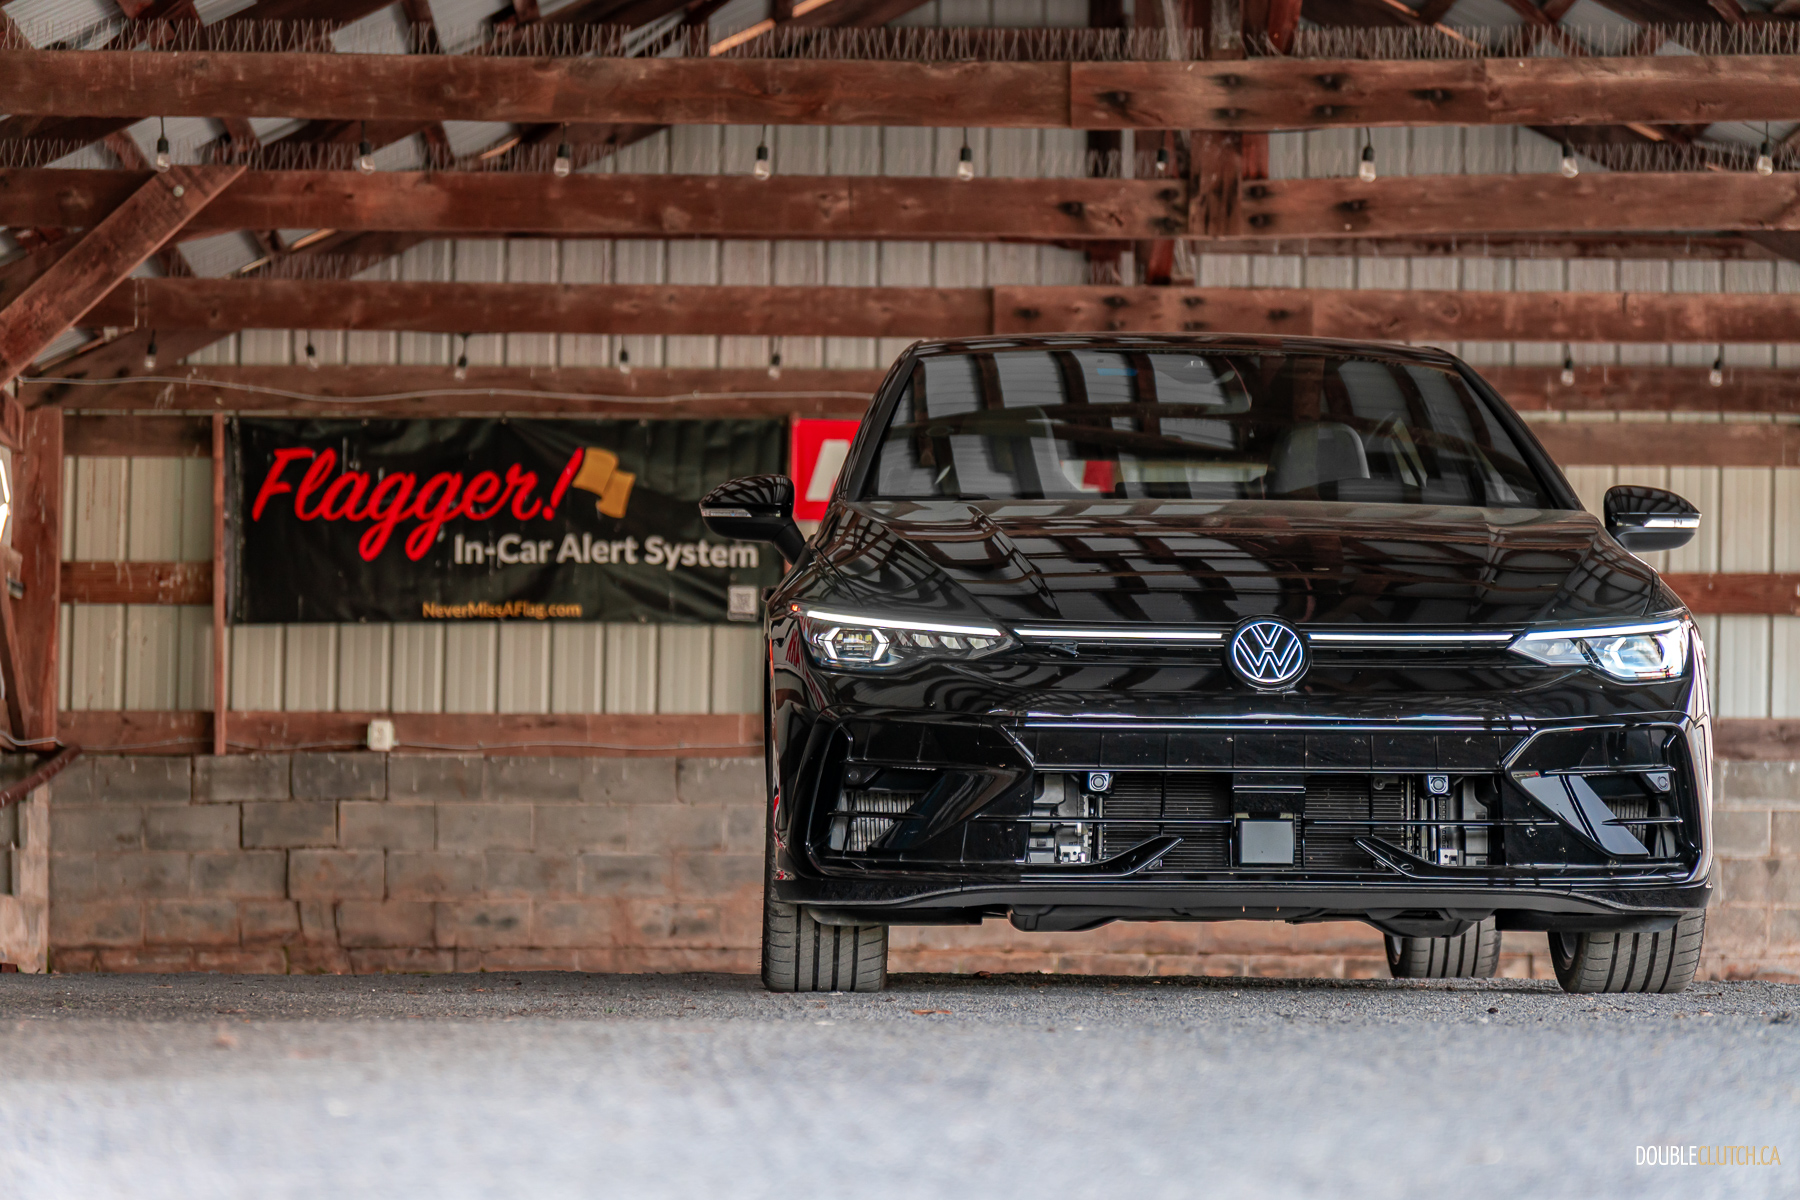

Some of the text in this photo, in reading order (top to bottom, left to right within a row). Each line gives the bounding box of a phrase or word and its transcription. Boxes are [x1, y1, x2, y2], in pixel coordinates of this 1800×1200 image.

[252, 446, 584, 562] Flagger!
[453, 531, 760, 572] In-Car Alert System
[421, 600, 584, 620] NeverMissAFlag.com
[1233, 621, 1303, 683] VW
